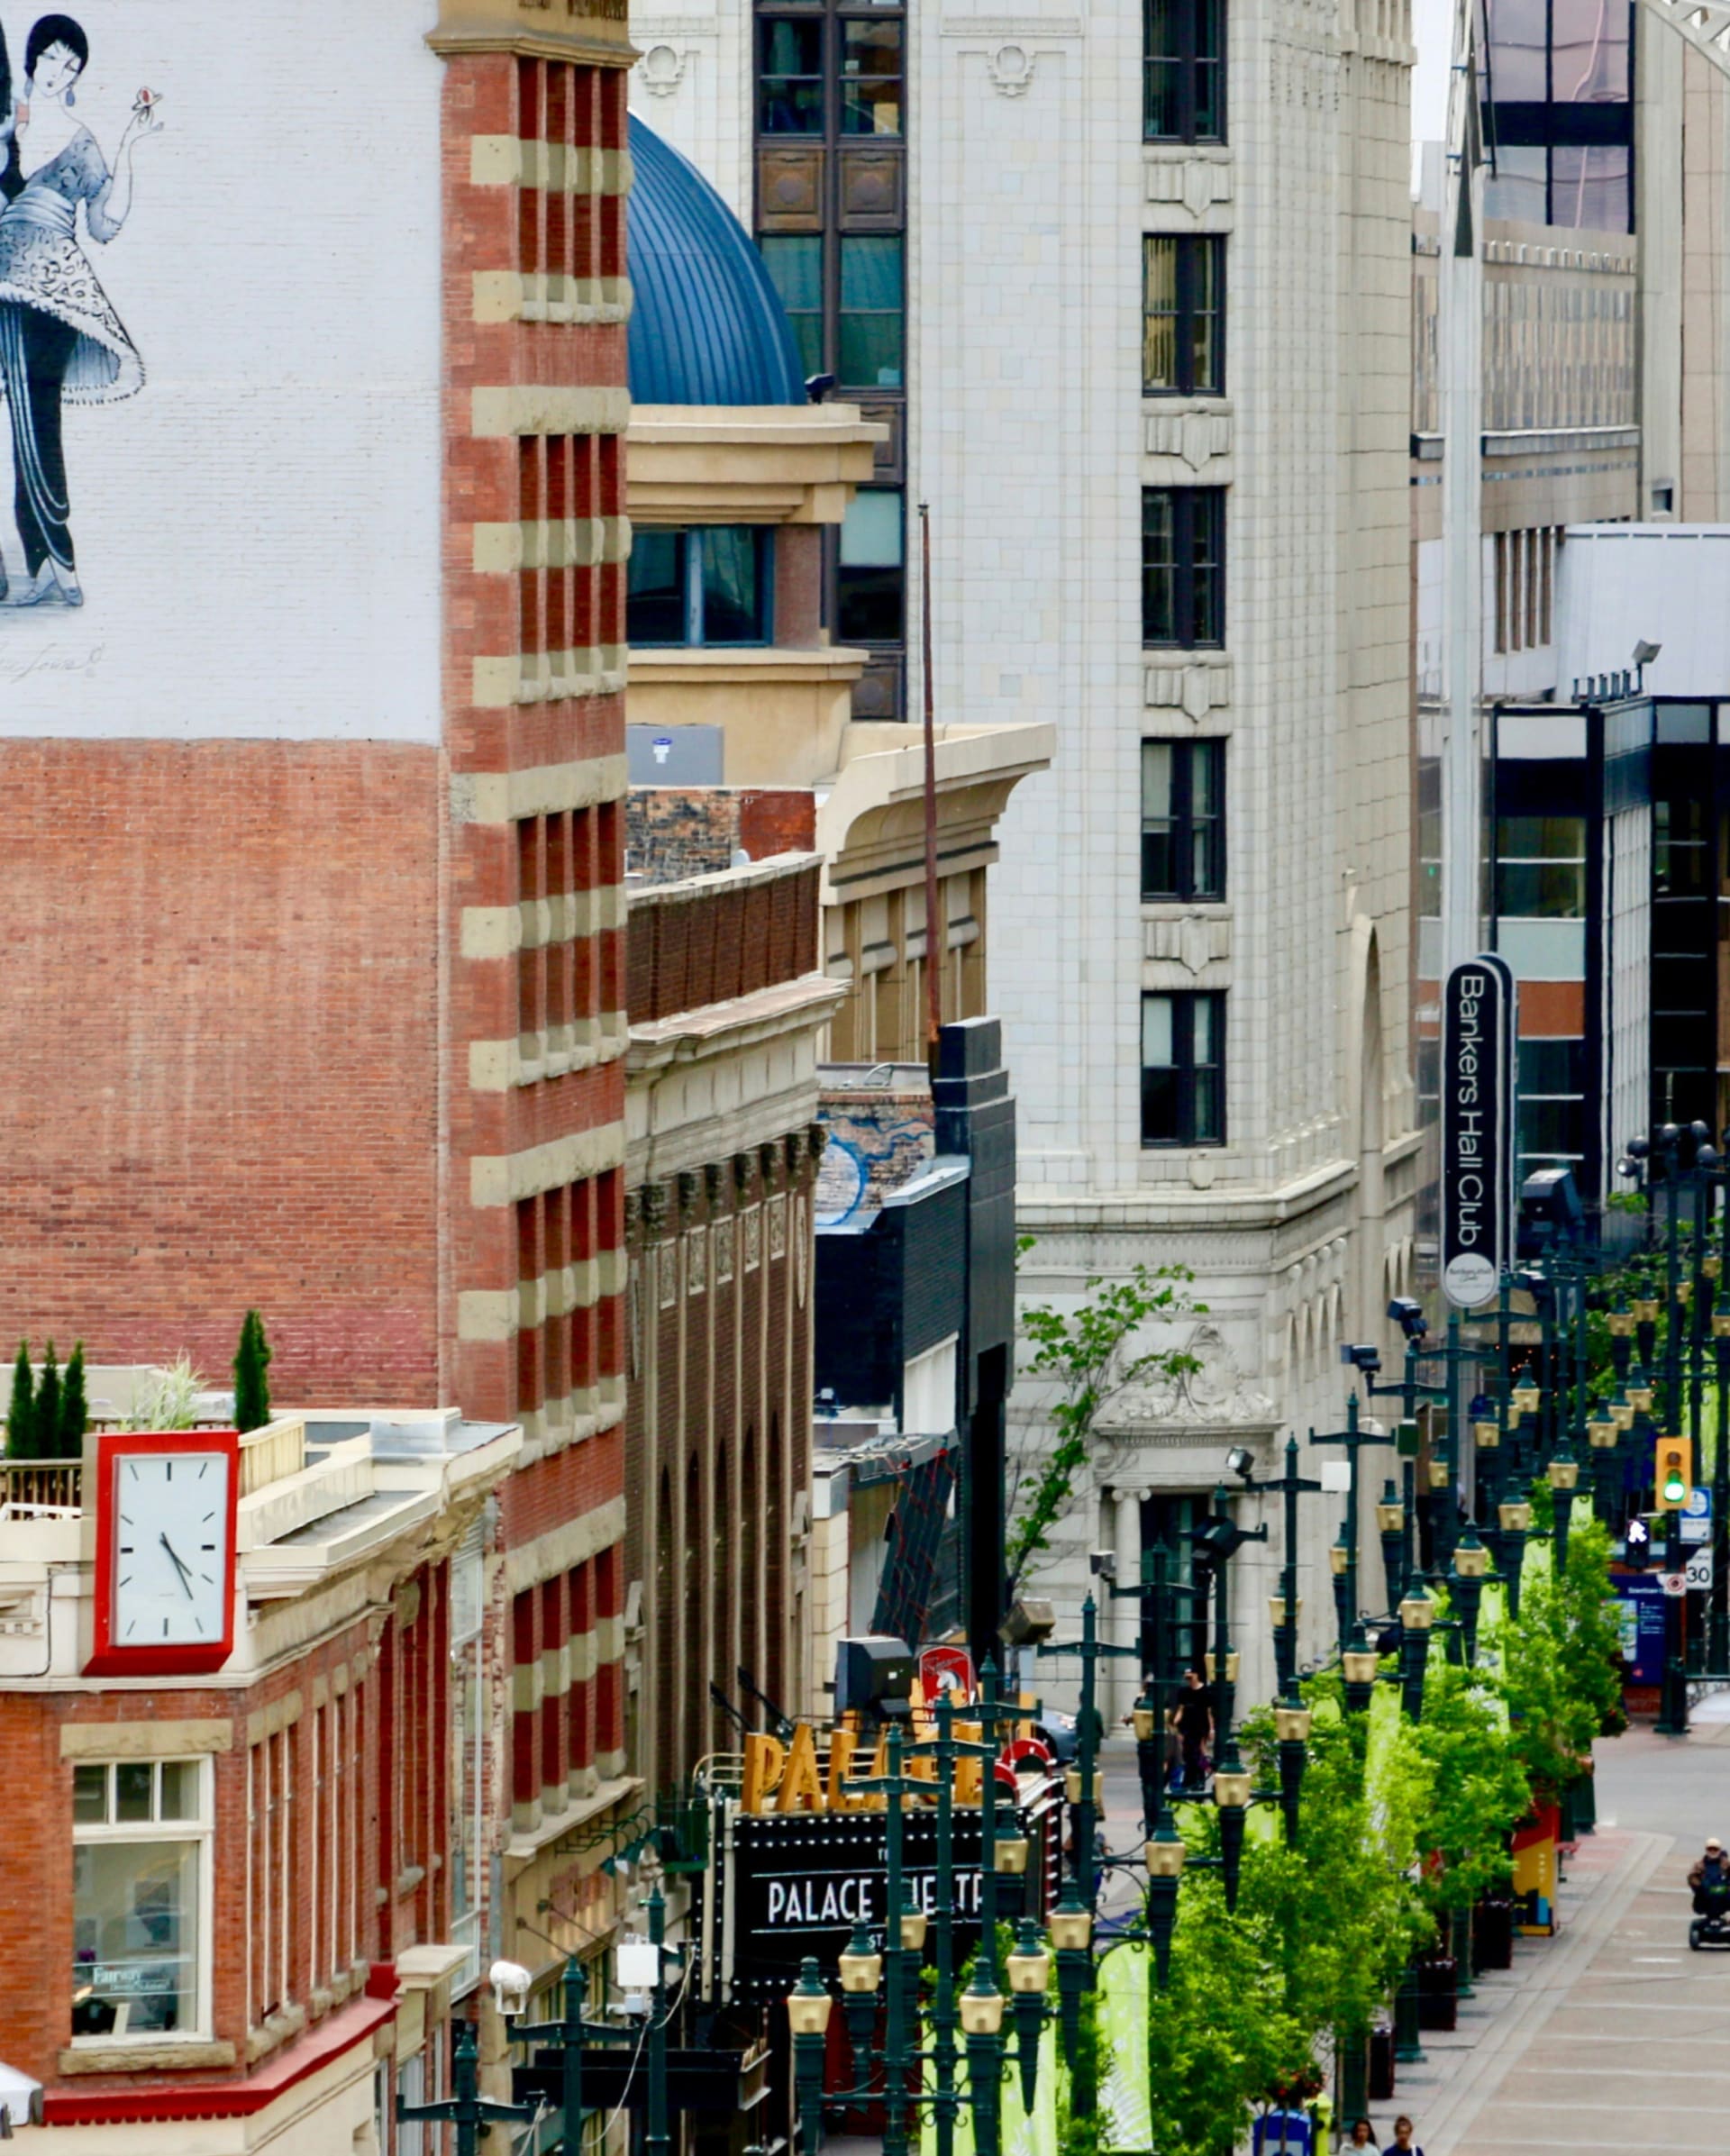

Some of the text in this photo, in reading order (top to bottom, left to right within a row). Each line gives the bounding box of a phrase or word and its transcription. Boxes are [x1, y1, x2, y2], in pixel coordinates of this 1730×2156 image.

[1458, 975, 1485, 1105] Bankers
[1458, 1112, 1483, 1169] Hall
[1458, 1174, 1484, 1247] Club
[1687, 1567, 1710, 1583] 30
[768, 1878, 873, 1924] PALACE
